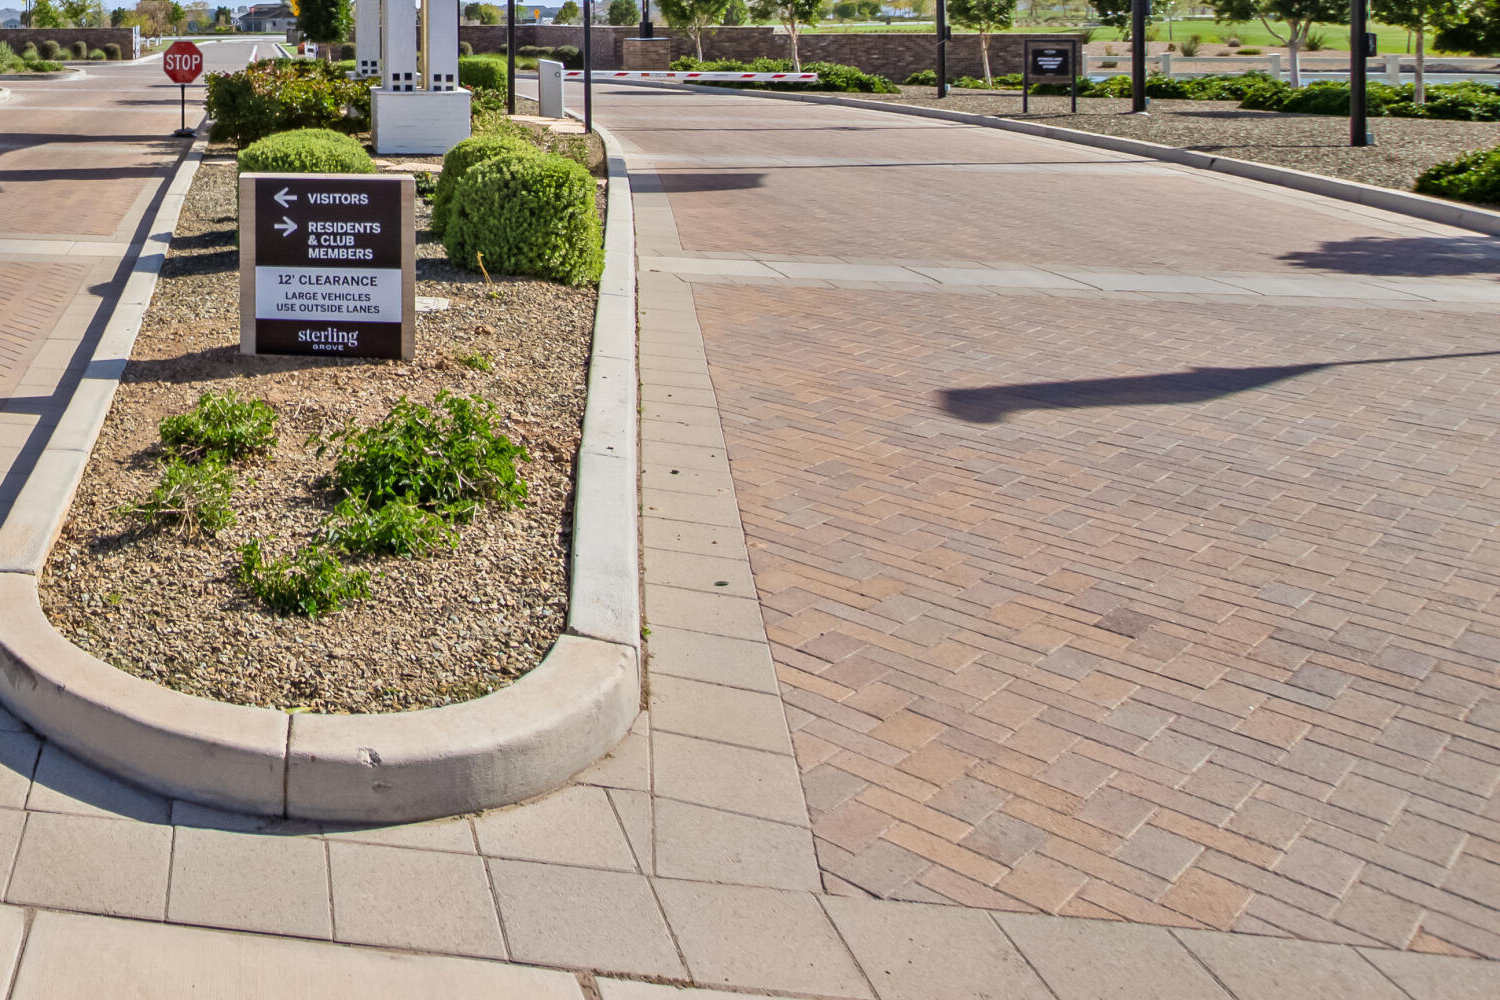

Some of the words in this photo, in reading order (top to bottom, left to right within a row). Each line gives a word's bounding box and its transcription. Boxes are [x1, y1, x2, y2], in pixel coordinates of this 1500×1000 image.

[165, 54, 201, 71] STOP
[307, 193, 369, 205] VISITORS
[308, 222, 381, 234] RESIDENTS
[307, 235, 318, 246] &
[320, 235, 355, 246] CLUB
[308, 248, 374, 260] MEMBERS
[278, 274, 295, 285] 12'
[298, 275, 378, 287] CLEARANCE
[285, 292, 318, 301] LARGE
[321, 292, 371, 302] VEHICLES
[276, 303, 296, 312] USE
[298, 304, 344, 313] OUTSIDE
[346, 304, 380, 314] LANES
[297, 327, 359, 347] sterling
